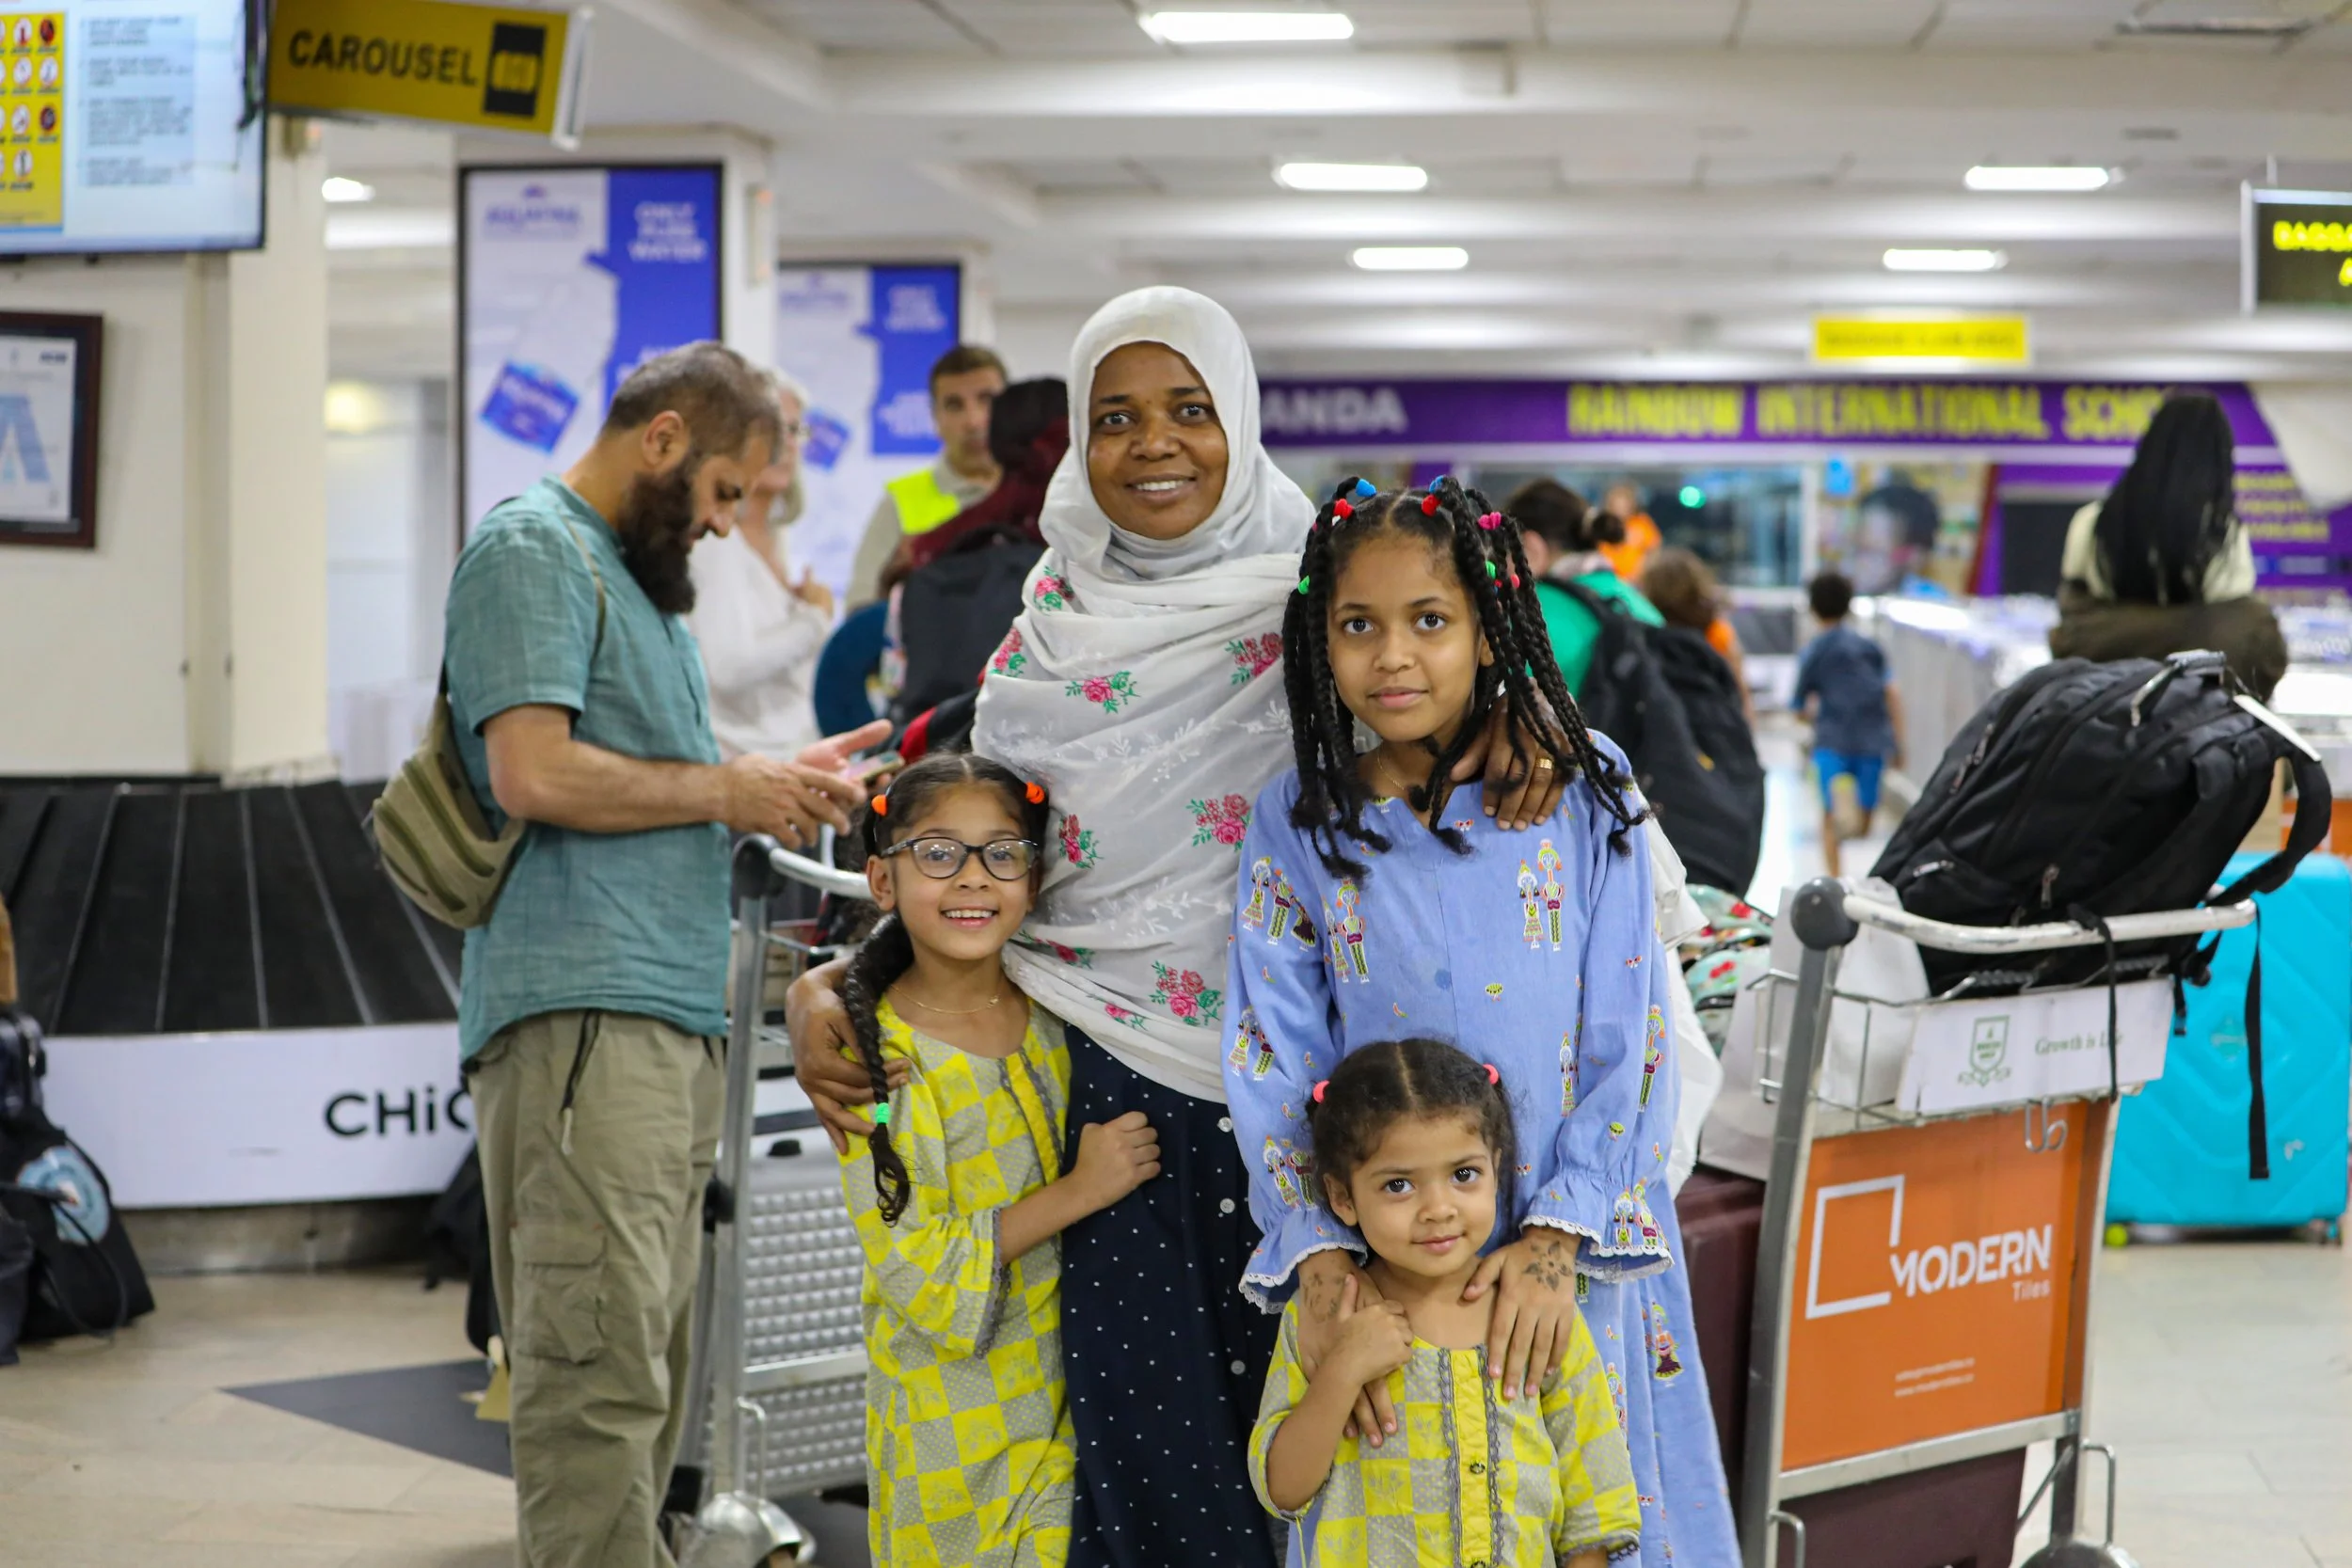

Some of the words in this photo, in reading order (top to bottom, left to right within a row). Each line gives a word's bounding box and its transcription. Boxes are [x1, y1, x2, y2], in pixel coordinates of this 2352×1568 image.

[288, 29, 478, 87] CAROUSEL
[1567, 385, 1744, 436] RAINBOW
[1756, 384, 2050, 439] INTERNATIONAL
[2035, 1032, 2083, 1055] Growth
[2086, 1031, 2095, 1050] is
[1890, 1224, 2053, 1298] MODERN
[2012, 1280, 2050, 1302] Tiles
